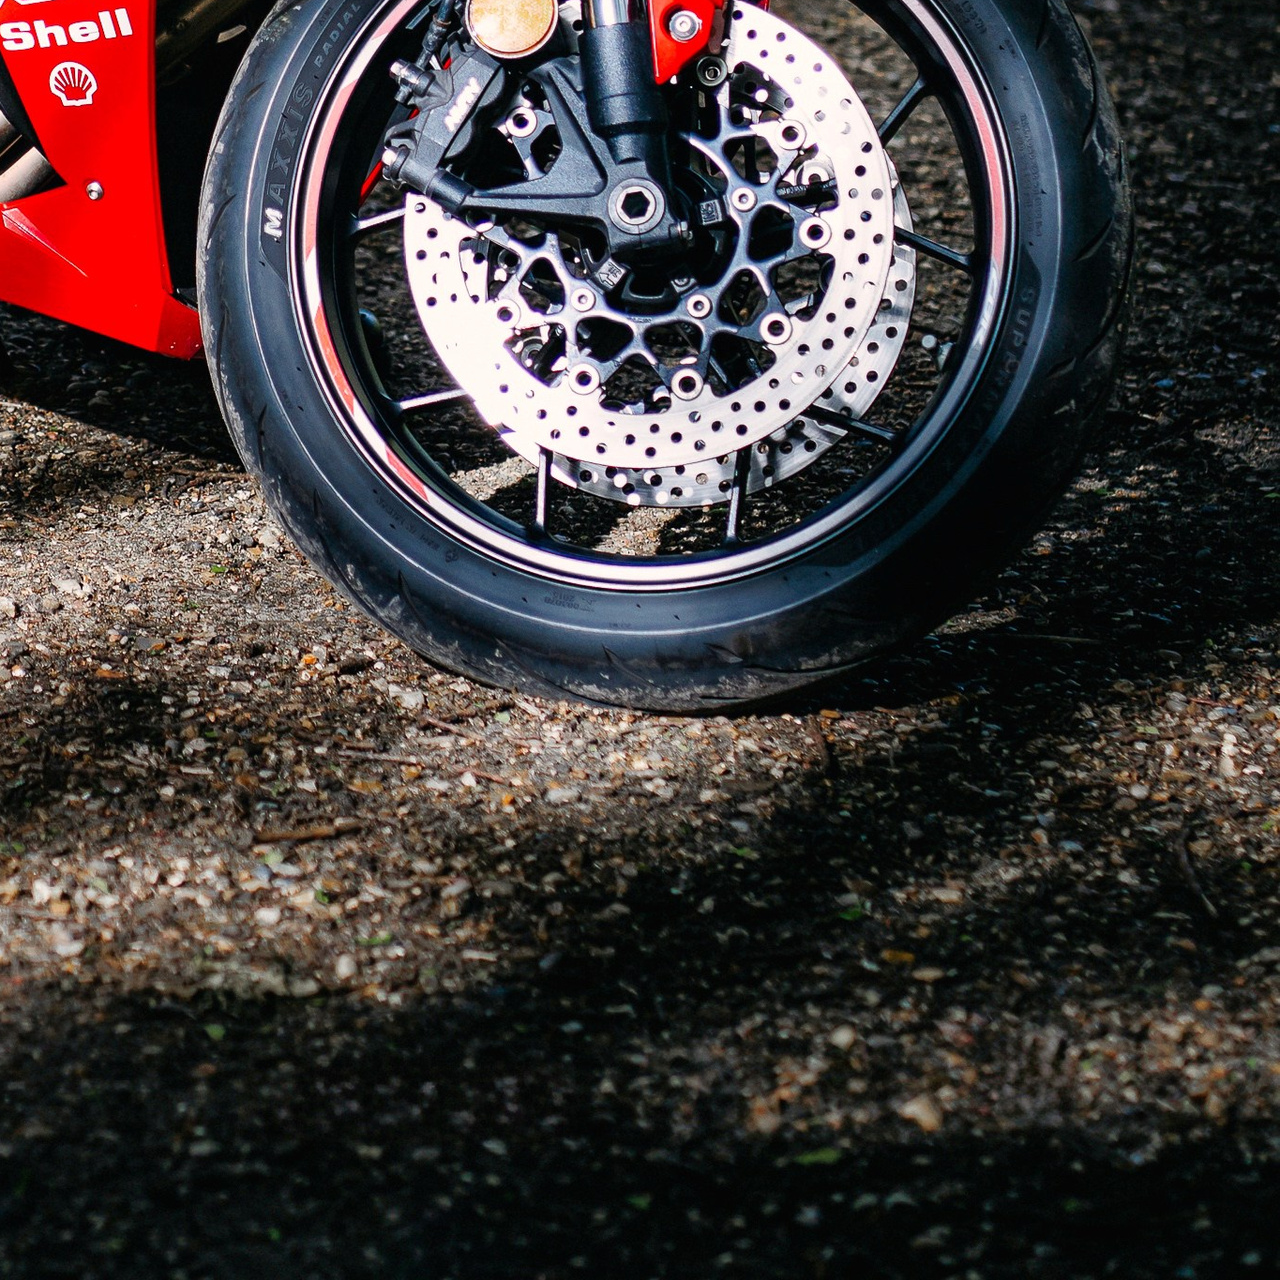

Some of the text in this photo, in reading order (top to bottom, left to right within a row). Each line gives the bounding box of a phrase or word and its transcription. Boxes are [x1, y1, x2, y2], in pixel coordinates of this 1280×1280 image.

[0, 7, 133, 51] Shell
[263, 2, 362, 241] MAXXIS RADIAL
